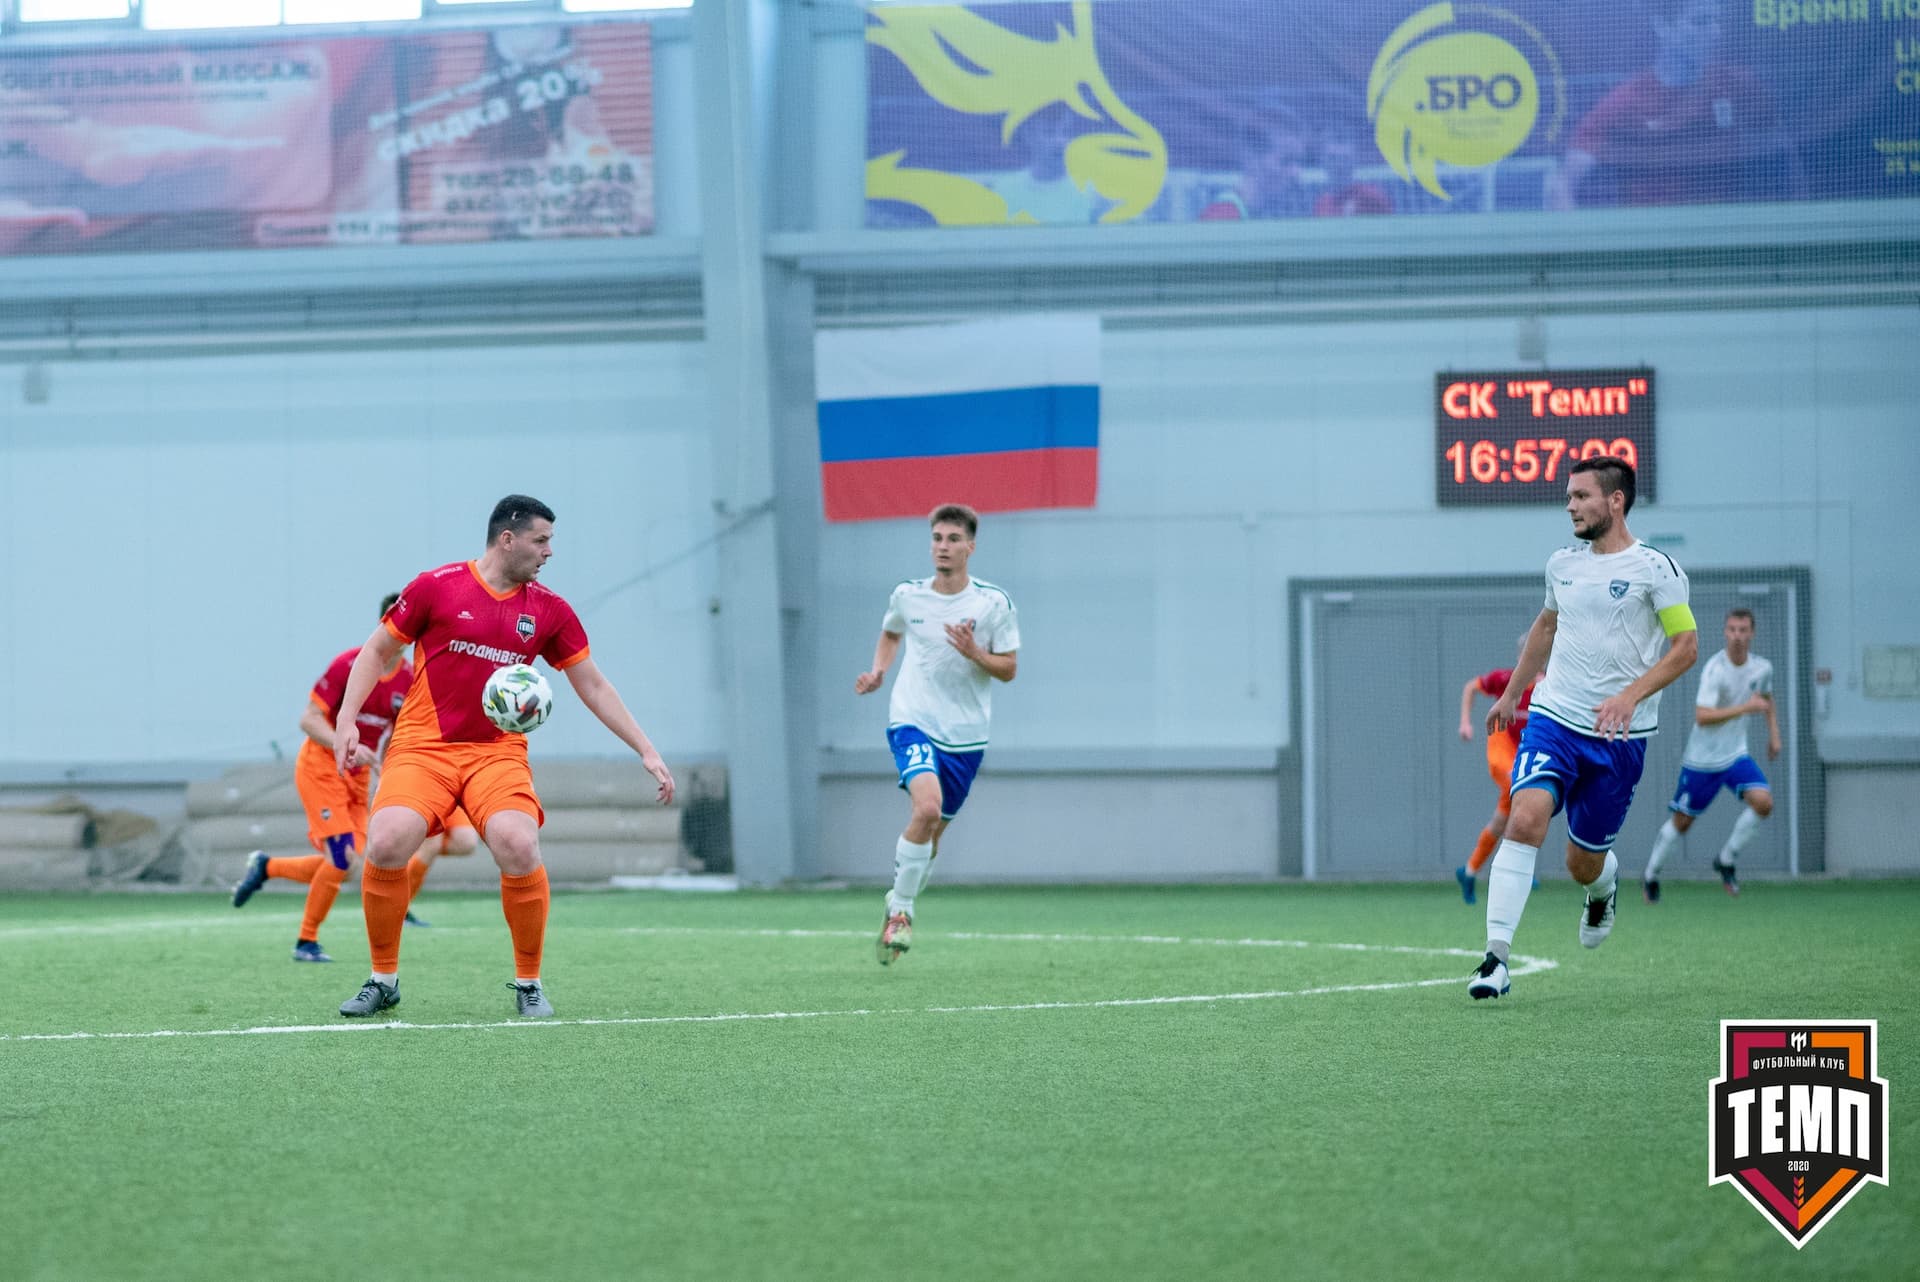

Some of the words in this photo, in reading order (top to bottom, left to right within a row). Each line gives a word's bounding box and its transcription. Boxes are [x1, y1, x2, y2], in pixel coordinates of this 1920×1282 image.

[1443, 381, 1498, 419] СК
[1507, 378, 1648, 418] "Темп"
[1516, 751, 1552, 781] 17
